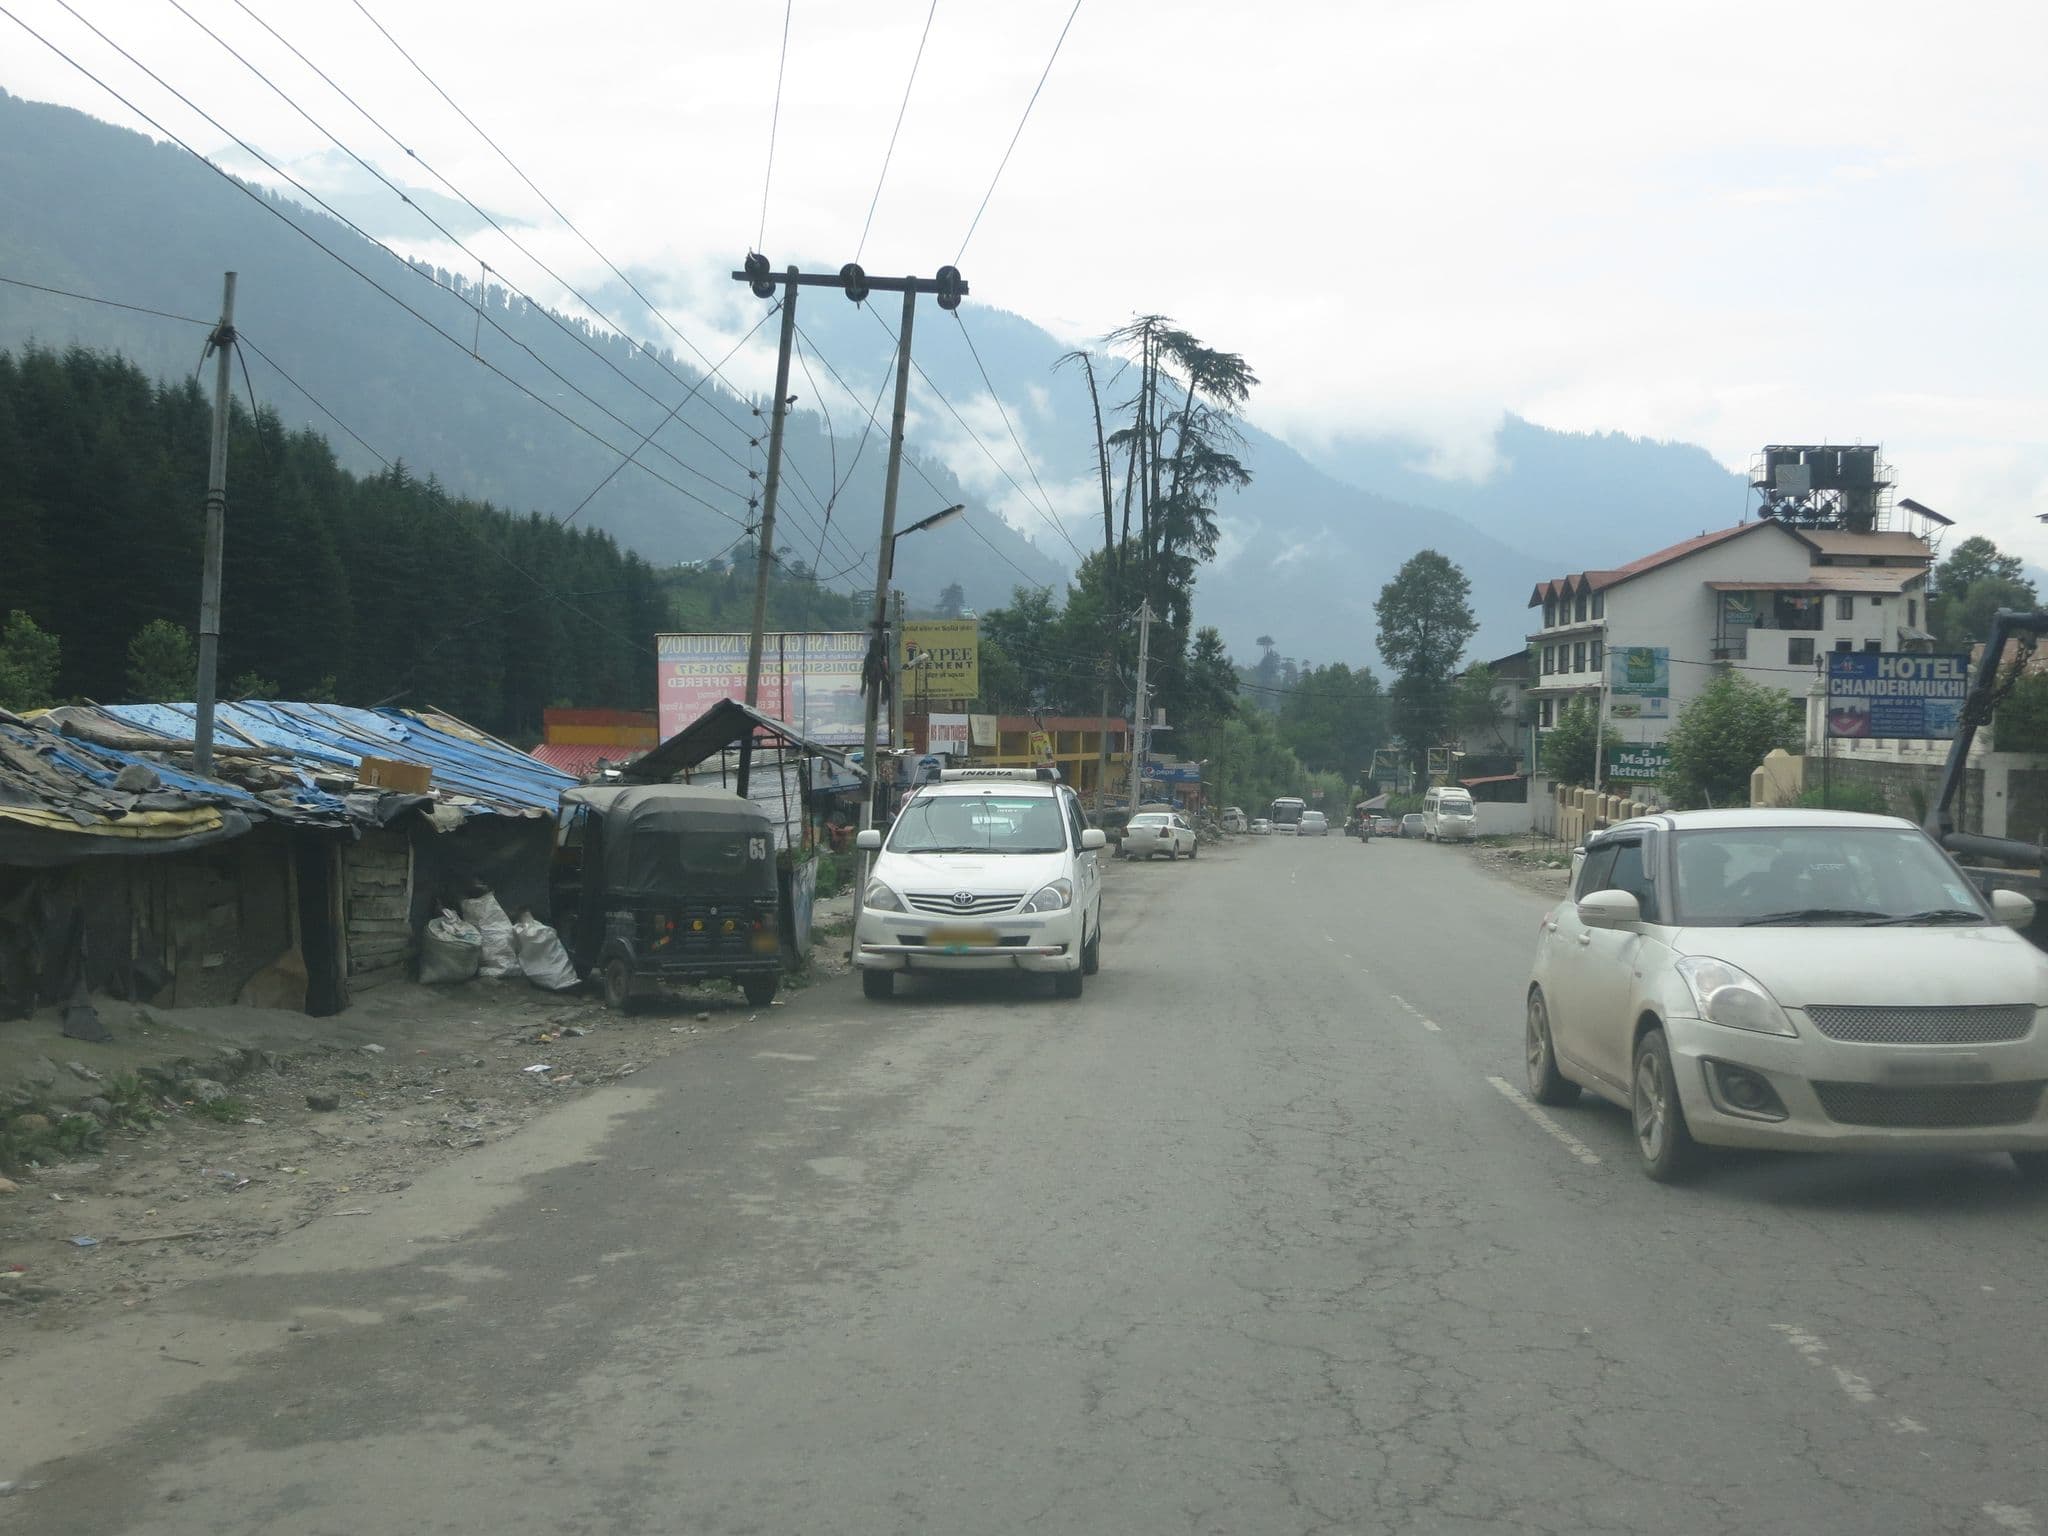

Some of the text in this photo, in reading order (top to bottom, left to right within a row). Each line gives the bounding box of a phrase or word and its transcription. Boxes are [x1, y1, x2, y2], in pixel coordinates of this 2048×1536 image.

[918, 661, 973, 669] CEMENT
[1878, 657, 1965, 679] HOTEL
[1831, 678, 1965, 697] CHANDERMUKHI
[1620, 753, 1670, 766] Maple
[1610, 764, 1656, 778] Retreat
[750, 838, 765, 860] 63
